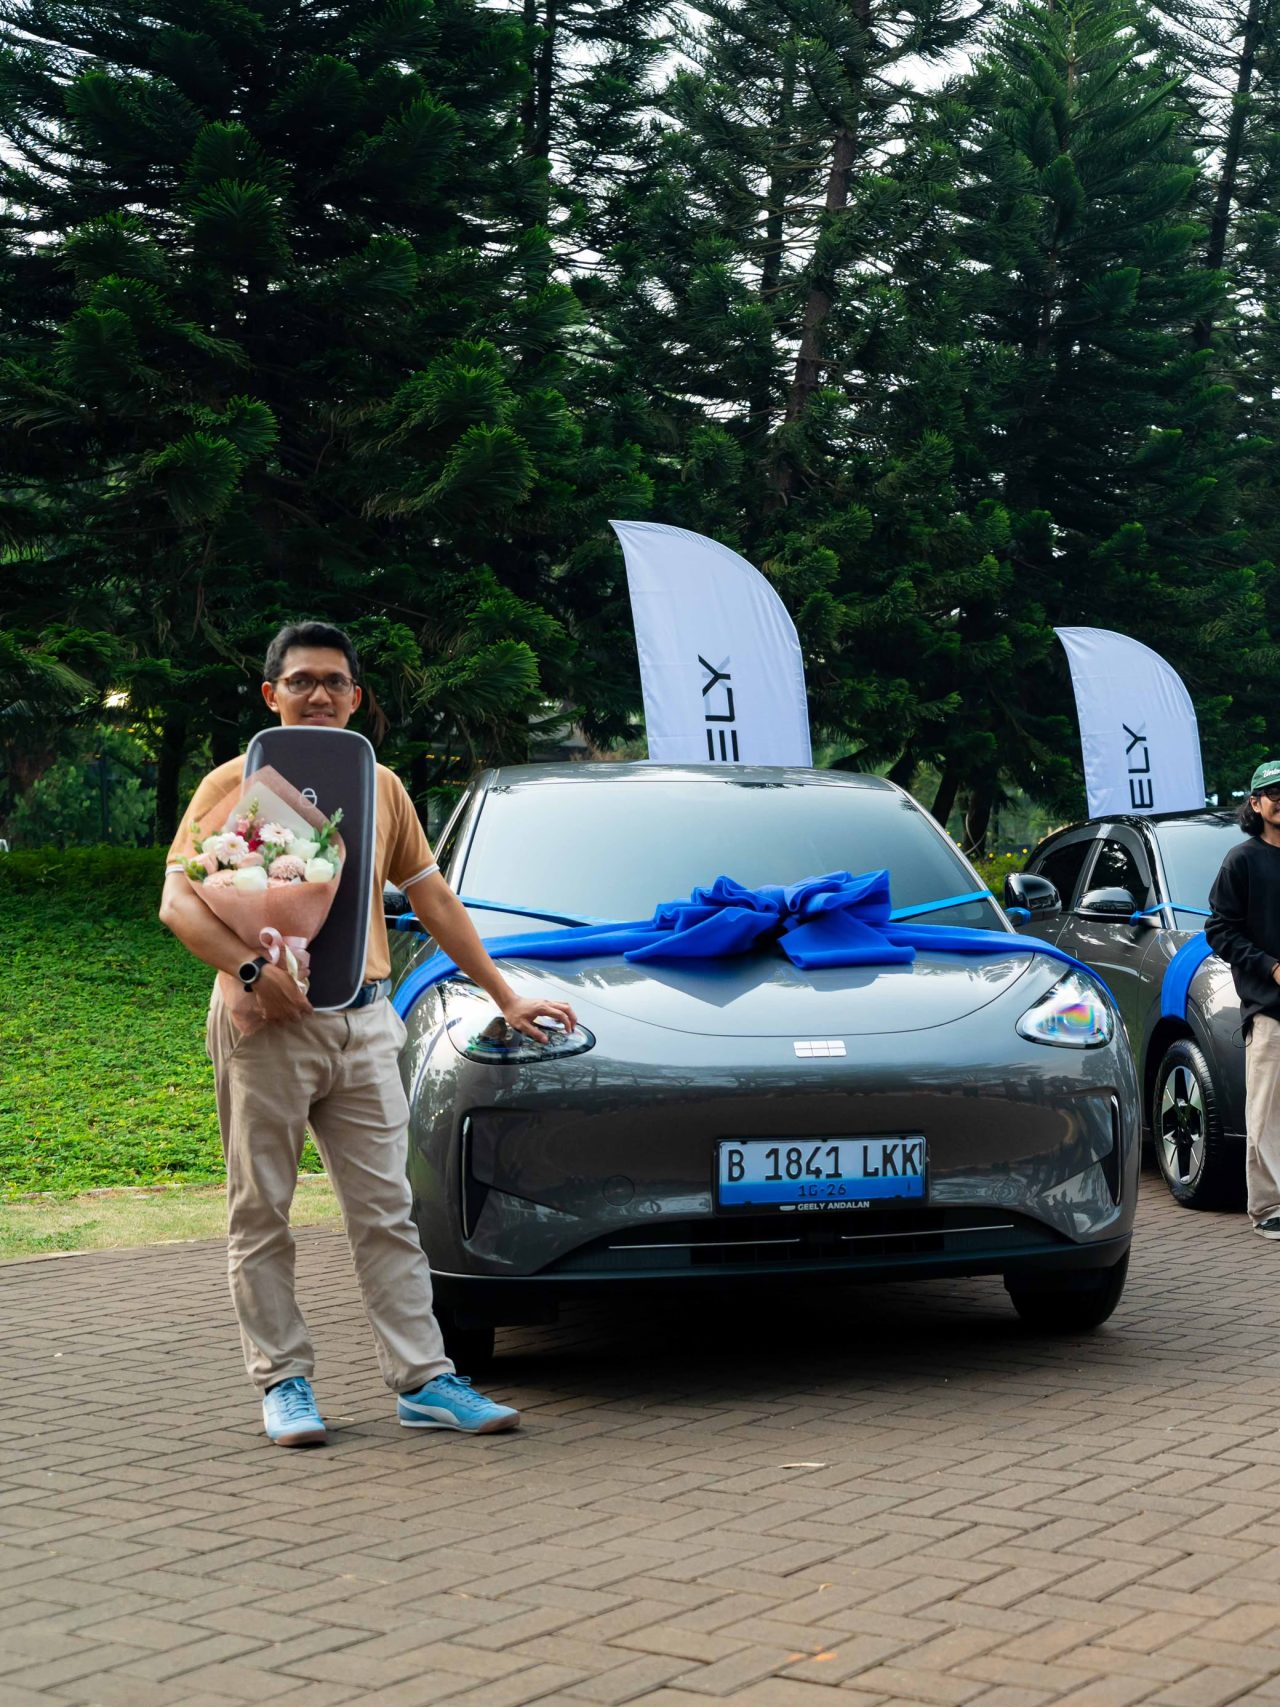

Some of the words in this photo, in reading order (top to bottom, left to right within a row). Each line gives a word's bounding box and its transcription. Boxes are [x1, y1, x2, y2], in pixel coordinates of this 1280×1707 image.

[1122, 723, 1154, 809] ELY
[728, 1149, 745, 1182] B
[765, 1146, 843, 1181] 1841
[863, 1144, 919, 1177] LKK
[797, 1202, 826, 1211] GEELY
[827, 1201, 870, 1210] ANDALAN
